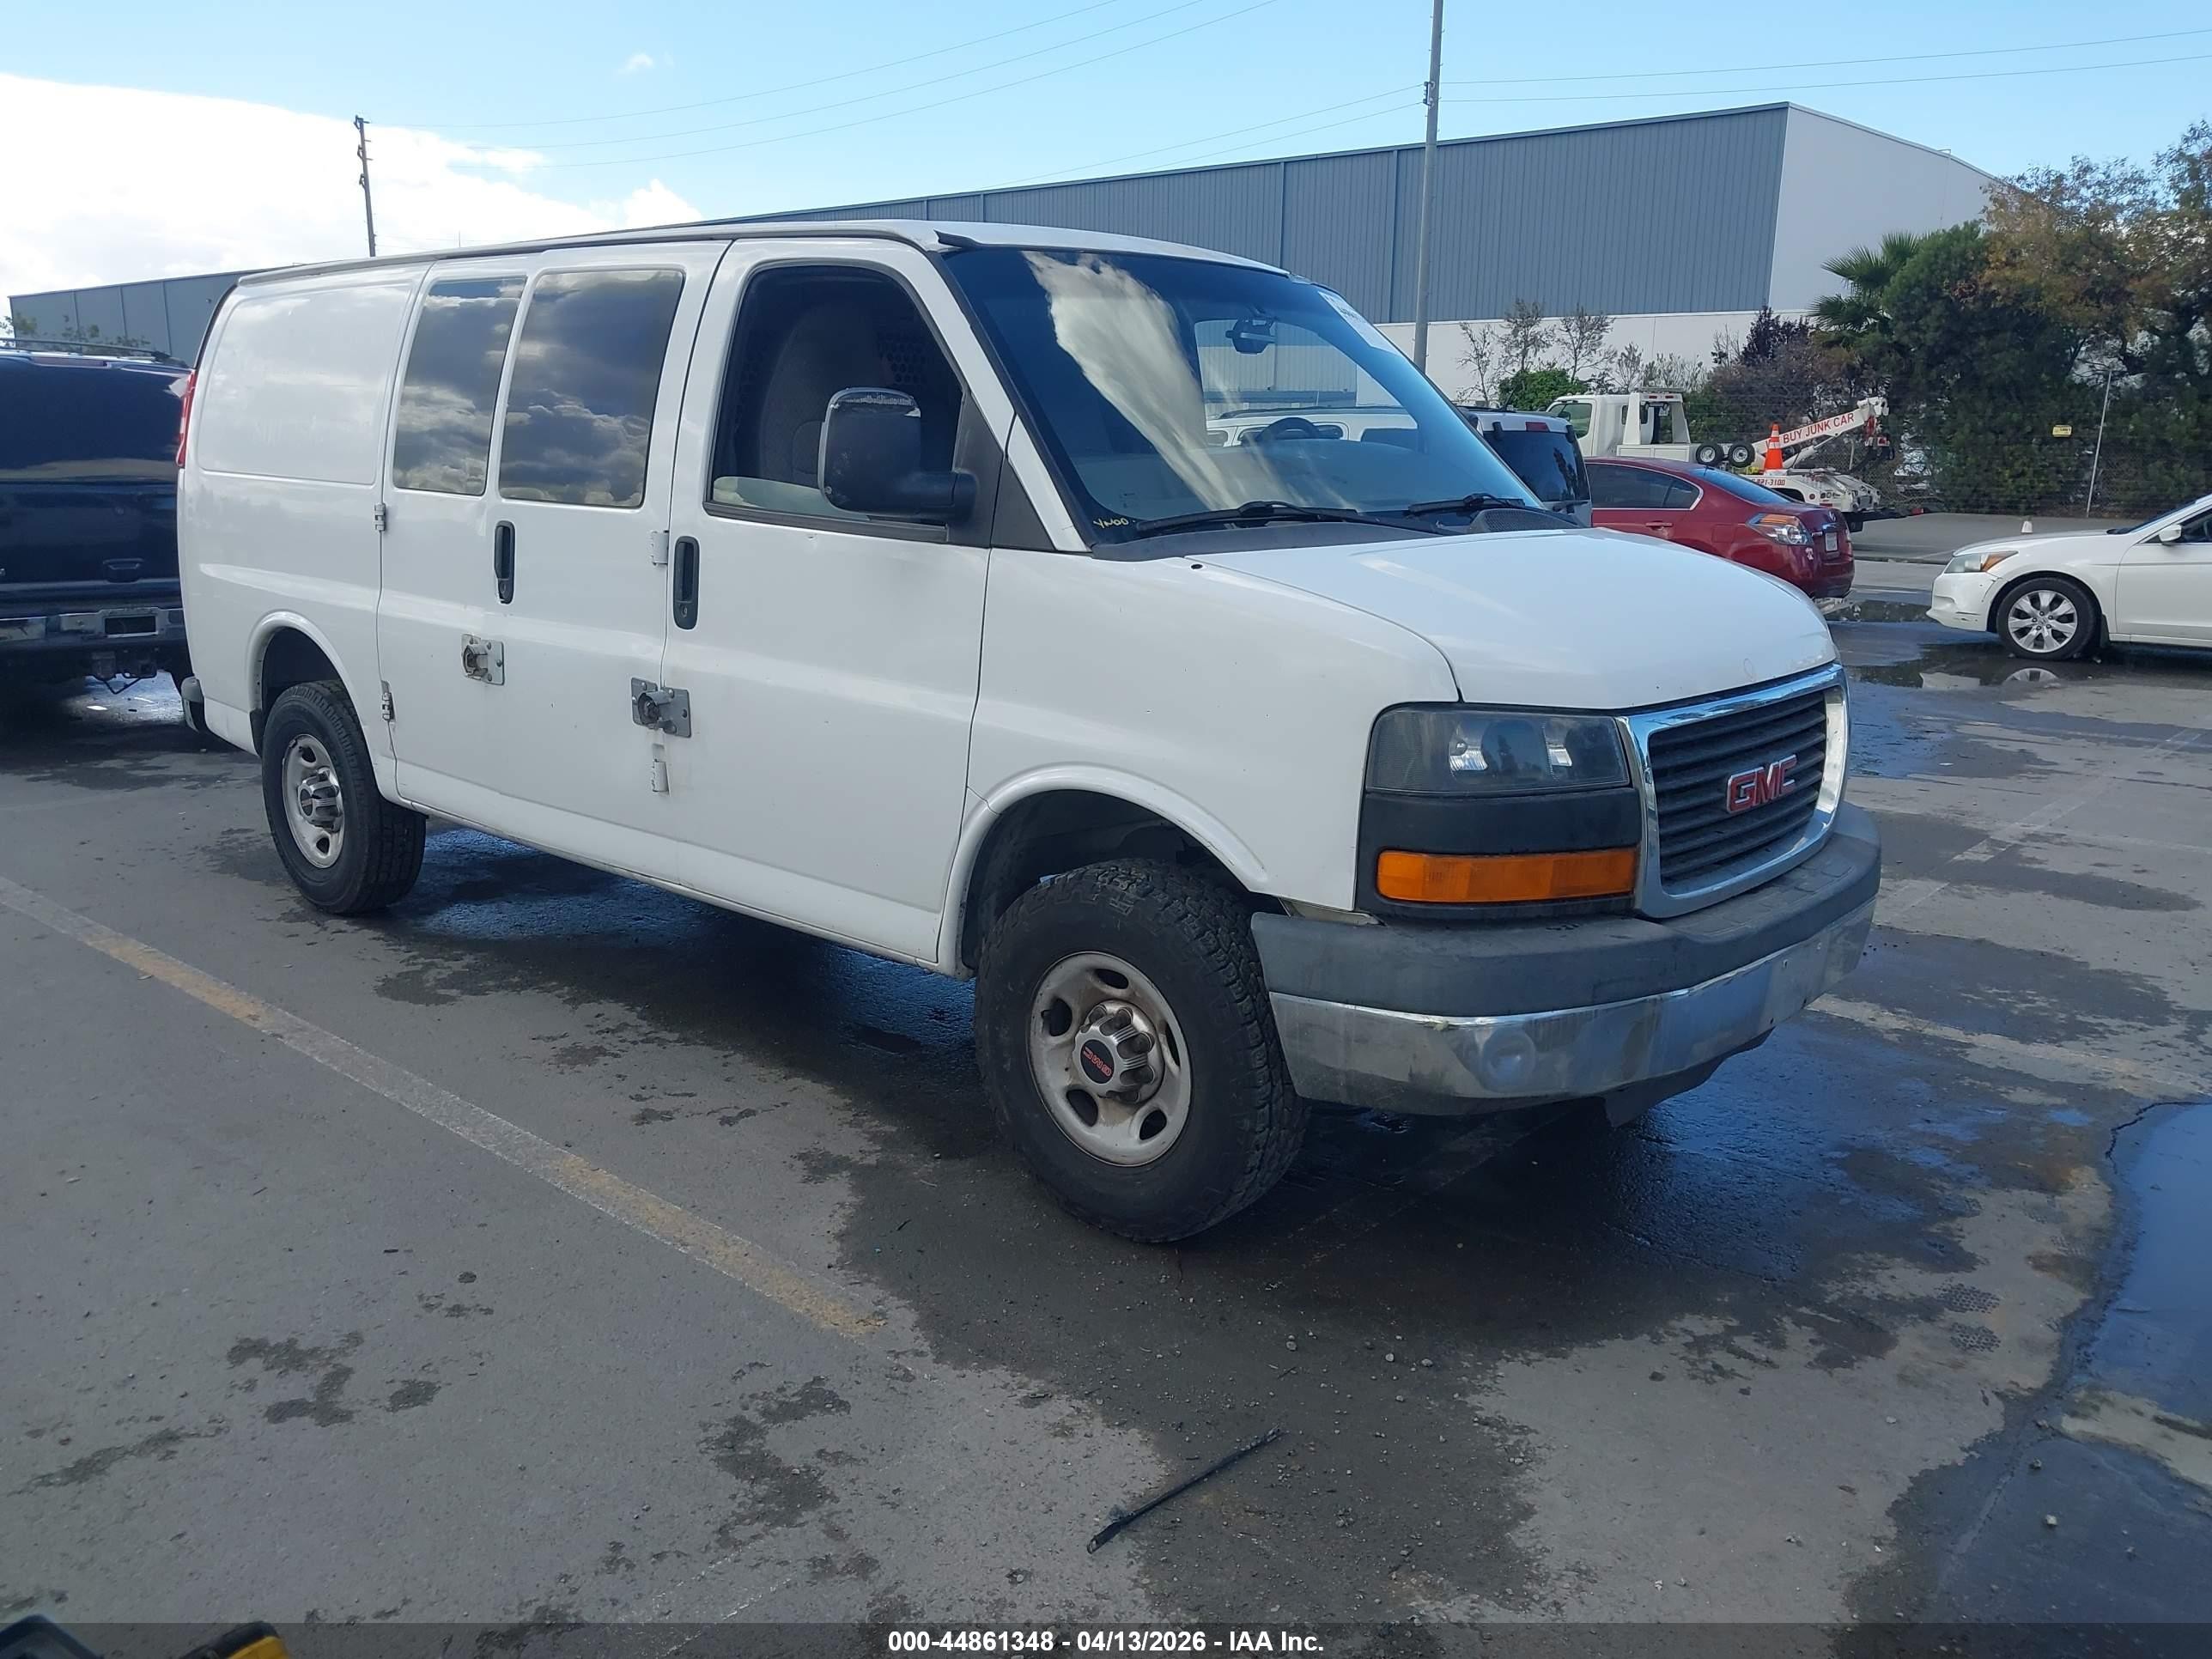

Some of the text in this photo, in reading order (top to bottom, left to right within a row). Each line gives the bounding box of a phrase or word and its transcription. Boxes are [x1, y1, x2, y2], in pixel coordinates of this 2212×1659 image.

[1784, 412, 1855, 444] BUY JUNK CAR
[1726, 754, 1798, 815] GMC
[1083, 1045, 1112, 1077] GMC
